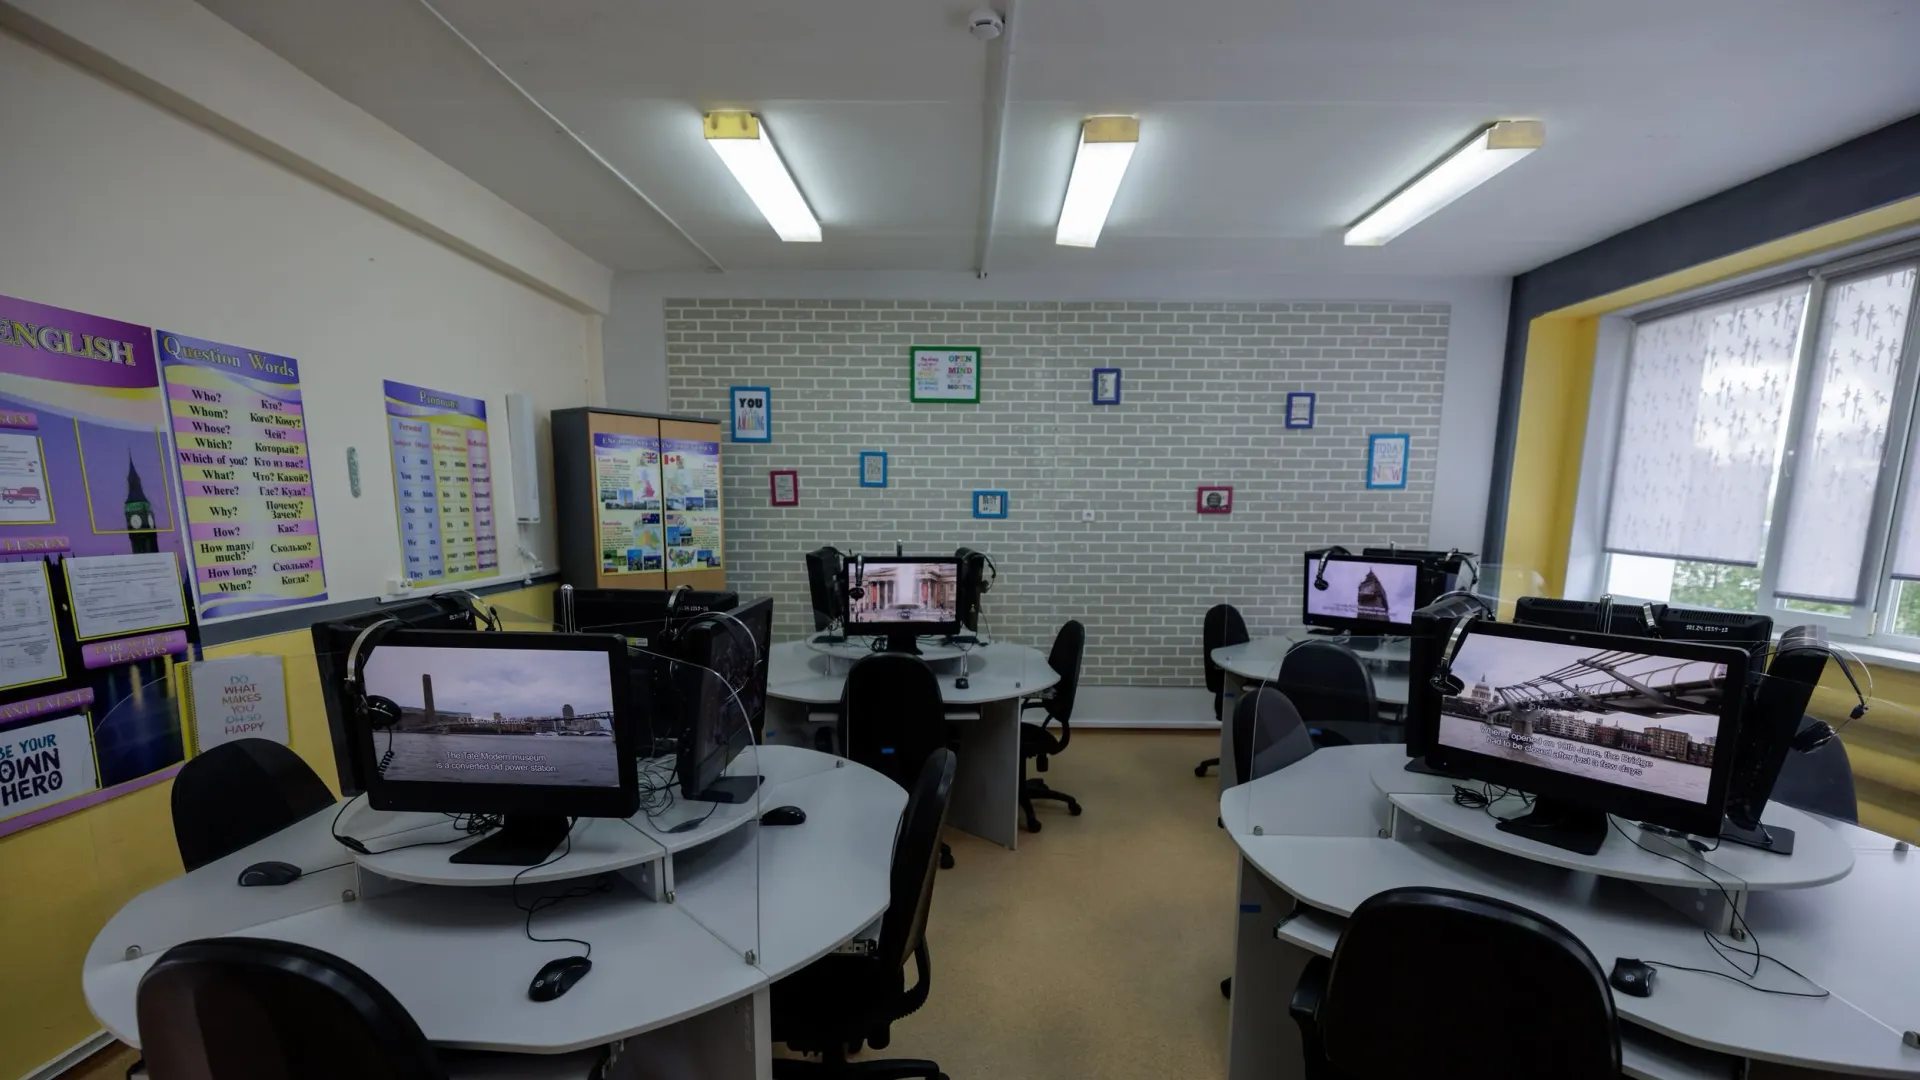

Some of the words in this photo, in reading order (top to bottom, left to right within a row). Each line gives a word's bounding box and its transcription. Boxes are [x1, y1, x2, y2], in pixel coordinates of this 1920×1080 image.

[0, 317, 136, 366] ENGLISH
[164, 336, 241, 368] Question
[247, 352, 295, 377] Words
[192, 389, 222, 403] Who?
[261, 399, 283, 411] Кто?
[738, 397, 763, 408] YOU
[189, 405, 229, 419] Whom?
[250, 412, 274, 425] Кого?
[275, 415, 301, 428] Кому?
[192, 421, 230, 434] Whose?
[264, 428, 287, 439] Чей?
[195, 437, 233, 450] Which?
[255, 442, 299, 456] Который?
[180, 452, 214, 464] Which
[217, 455, 226, 464] of
[229, 456, 249, 467] you?
[254, 456, 271, 466] Кто
[273, 459, 283, 468] из
[285, 459, 304, 469] вас?
[202, 469, 235, 480] What?
[252, 471, 275, 482] Что?
[277, 472, 309, 483] Какой?
[400, 471, 412, 480] You
[421, 474, 431, 482] you
[202, 485, 239, 496] Where?
[259, 486, 279, 497] Где?
[281, 486, 306, 498] Куда?
[266, 501, 304, 511] Почему?
[405, 505, 416, 514] She
[209, 506, 238, 519] Why?
[271, 509, 302, 519] Зачем?
[213, 527, 240, 538] How?
[277, 524, 299, 533] Как?
[5, 538, 66, 552] LESSON
[201, 543, 223, 554] How
[270, 542, 312, 554] Сколько?
[215, 551, 246, 562] much?
[408, 555, 420, 563] You
[429, 555, 439, 563] you
[208, 568, 231, 579] How
[232, 565, 257, 577] long?
[273, 560, 314, 572] Сколько?
[409, 571, 423, 580] They
[448, 566, 459, 574] their
[281, 574, 310, 585] Когда?
[219, 580, 252, 592] When?
[109, 647, 168, 662] LEAVERS
[230, 675, 249, 684] DO
[224, 683, 257, 694] WHAT
[222, 693, 262, 705] MAKES
[231, 704, 255, 714] YOU
[226, 714, 244, 723] OH
[246, 713, 262, 721] SO
[225, 721, 265, 735] HAPPY
[19, 733, 57, 754] YOUR
[446, 751, 461, 760] The
[463, 751, 479, 760] Tate
[480, 752, 511, 761] Modern
[512, 754, 547, 762] museum
[1486, 736, 1502, 746] had
[1512, 742, 1523, 750] be
[1524, 744, 1552, 755] closed
[1553, 750, 1574, 760] after
[1573, 755, 1591, 765] just
[1600, 760, 1617, 770] few
[1618, 764, 1643, 776] days
[1511, 733, 1543, 744] opened
[1604, 750, 1619, 761] the
[1621, 754, 1653, 768] Bridge
[0, 748, 61, 783] OWN
[435, 761, 443, 769] is
[451, 761, 489, 770] converted
[491, 762, 503, 771] old
[504, 765, 528, 773] power
[1, 770, 63, 806] HERO
